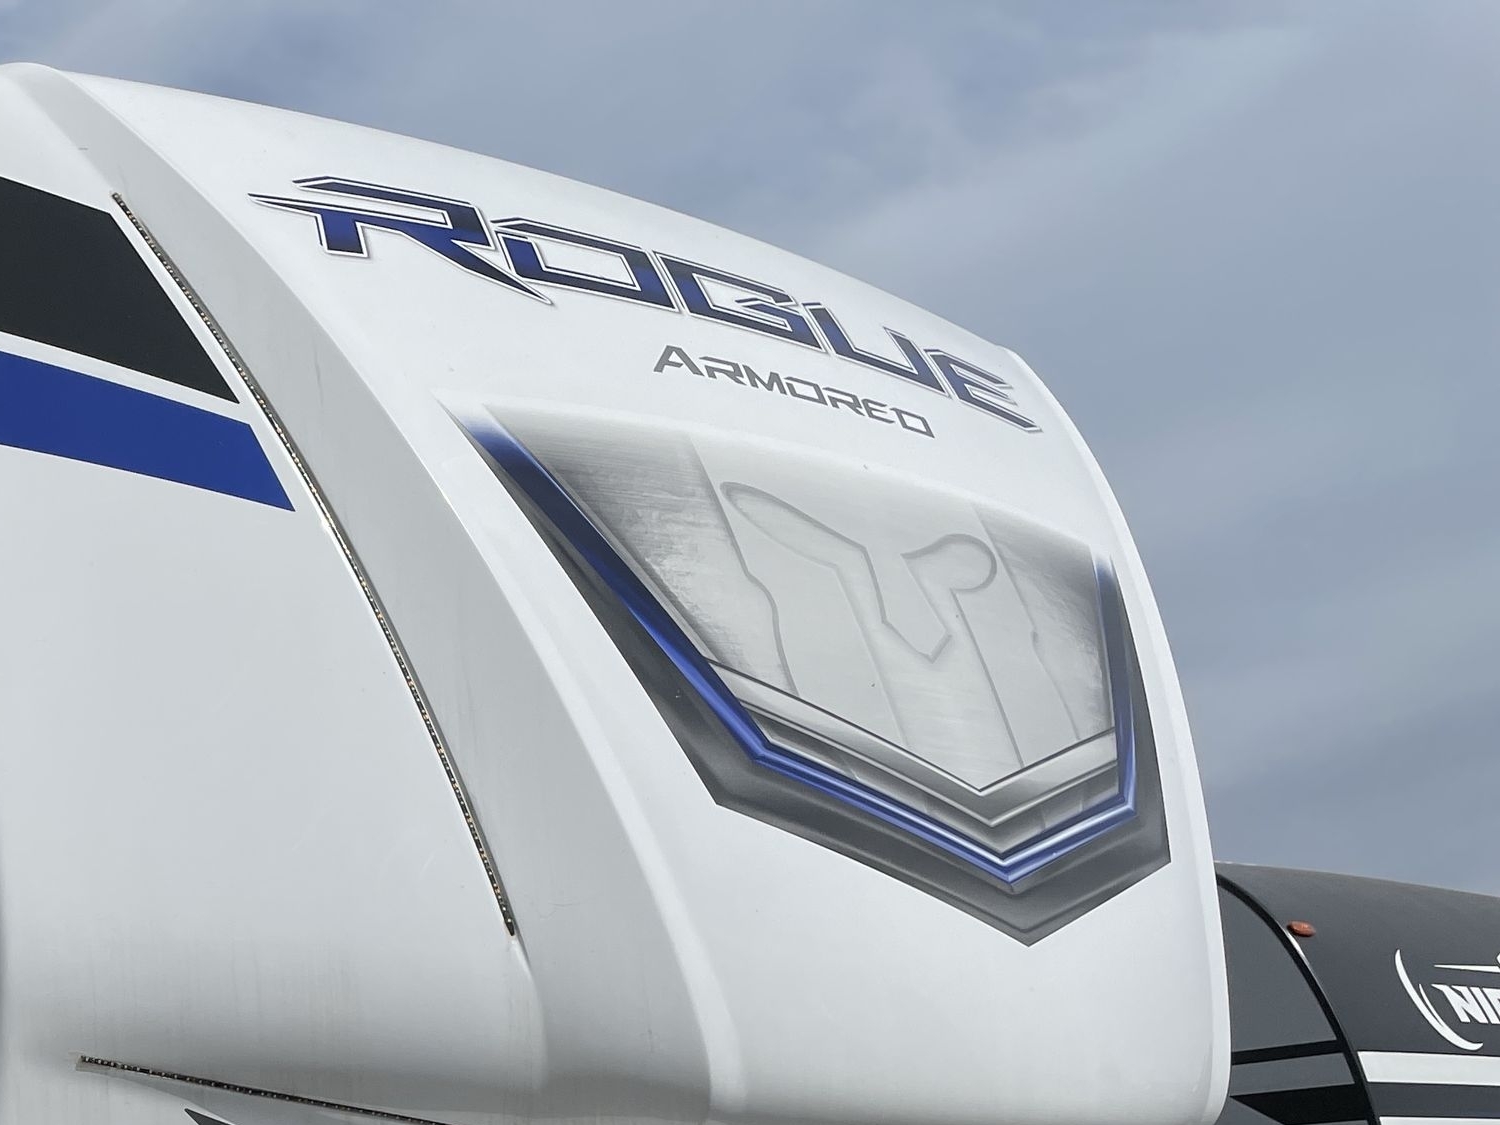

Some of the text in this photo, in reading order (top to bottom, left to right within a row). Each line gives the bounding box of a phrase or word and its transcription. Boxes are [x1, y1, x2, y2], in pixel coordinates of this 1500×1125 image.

[248, 176, 1043, 433] ROGUE
[653, 344, 935, 439] ARMORED
[1430, 983, 1500, 1025] NI
